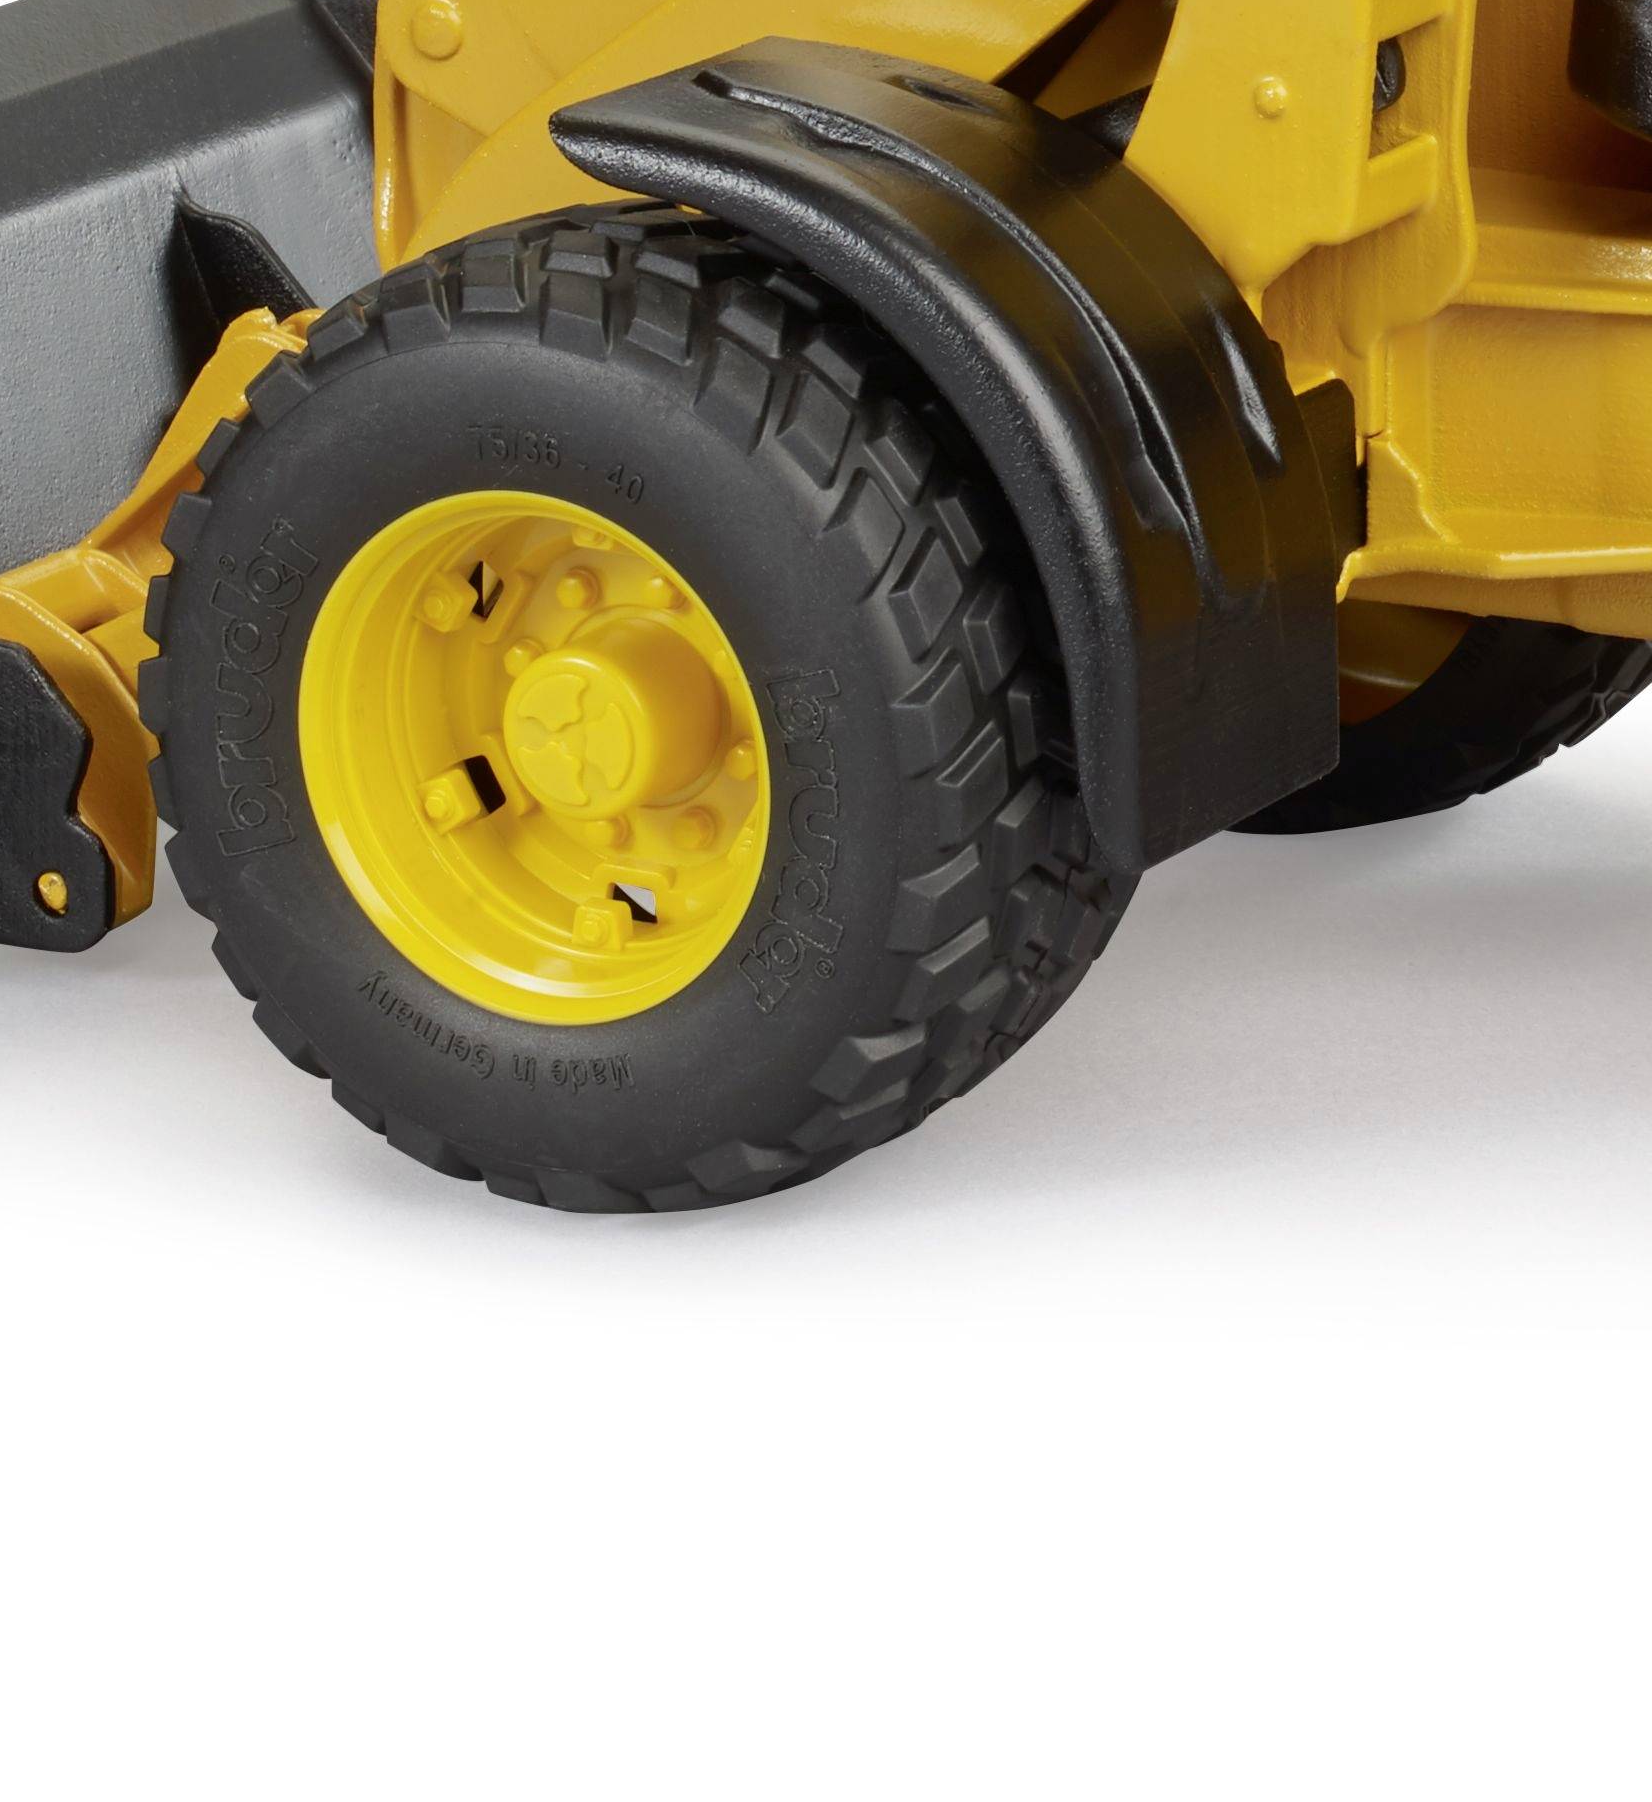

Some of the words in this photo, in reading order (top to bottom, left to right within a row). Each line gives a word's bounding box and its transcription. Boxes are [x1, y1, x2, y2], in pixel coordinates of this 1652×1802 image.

[605, 462, 644, 504] 40
[357, 972, 495, 1079] Germany
[513, 1054, 537, 1091] in
[551, 1053, 635, 1093] Made
